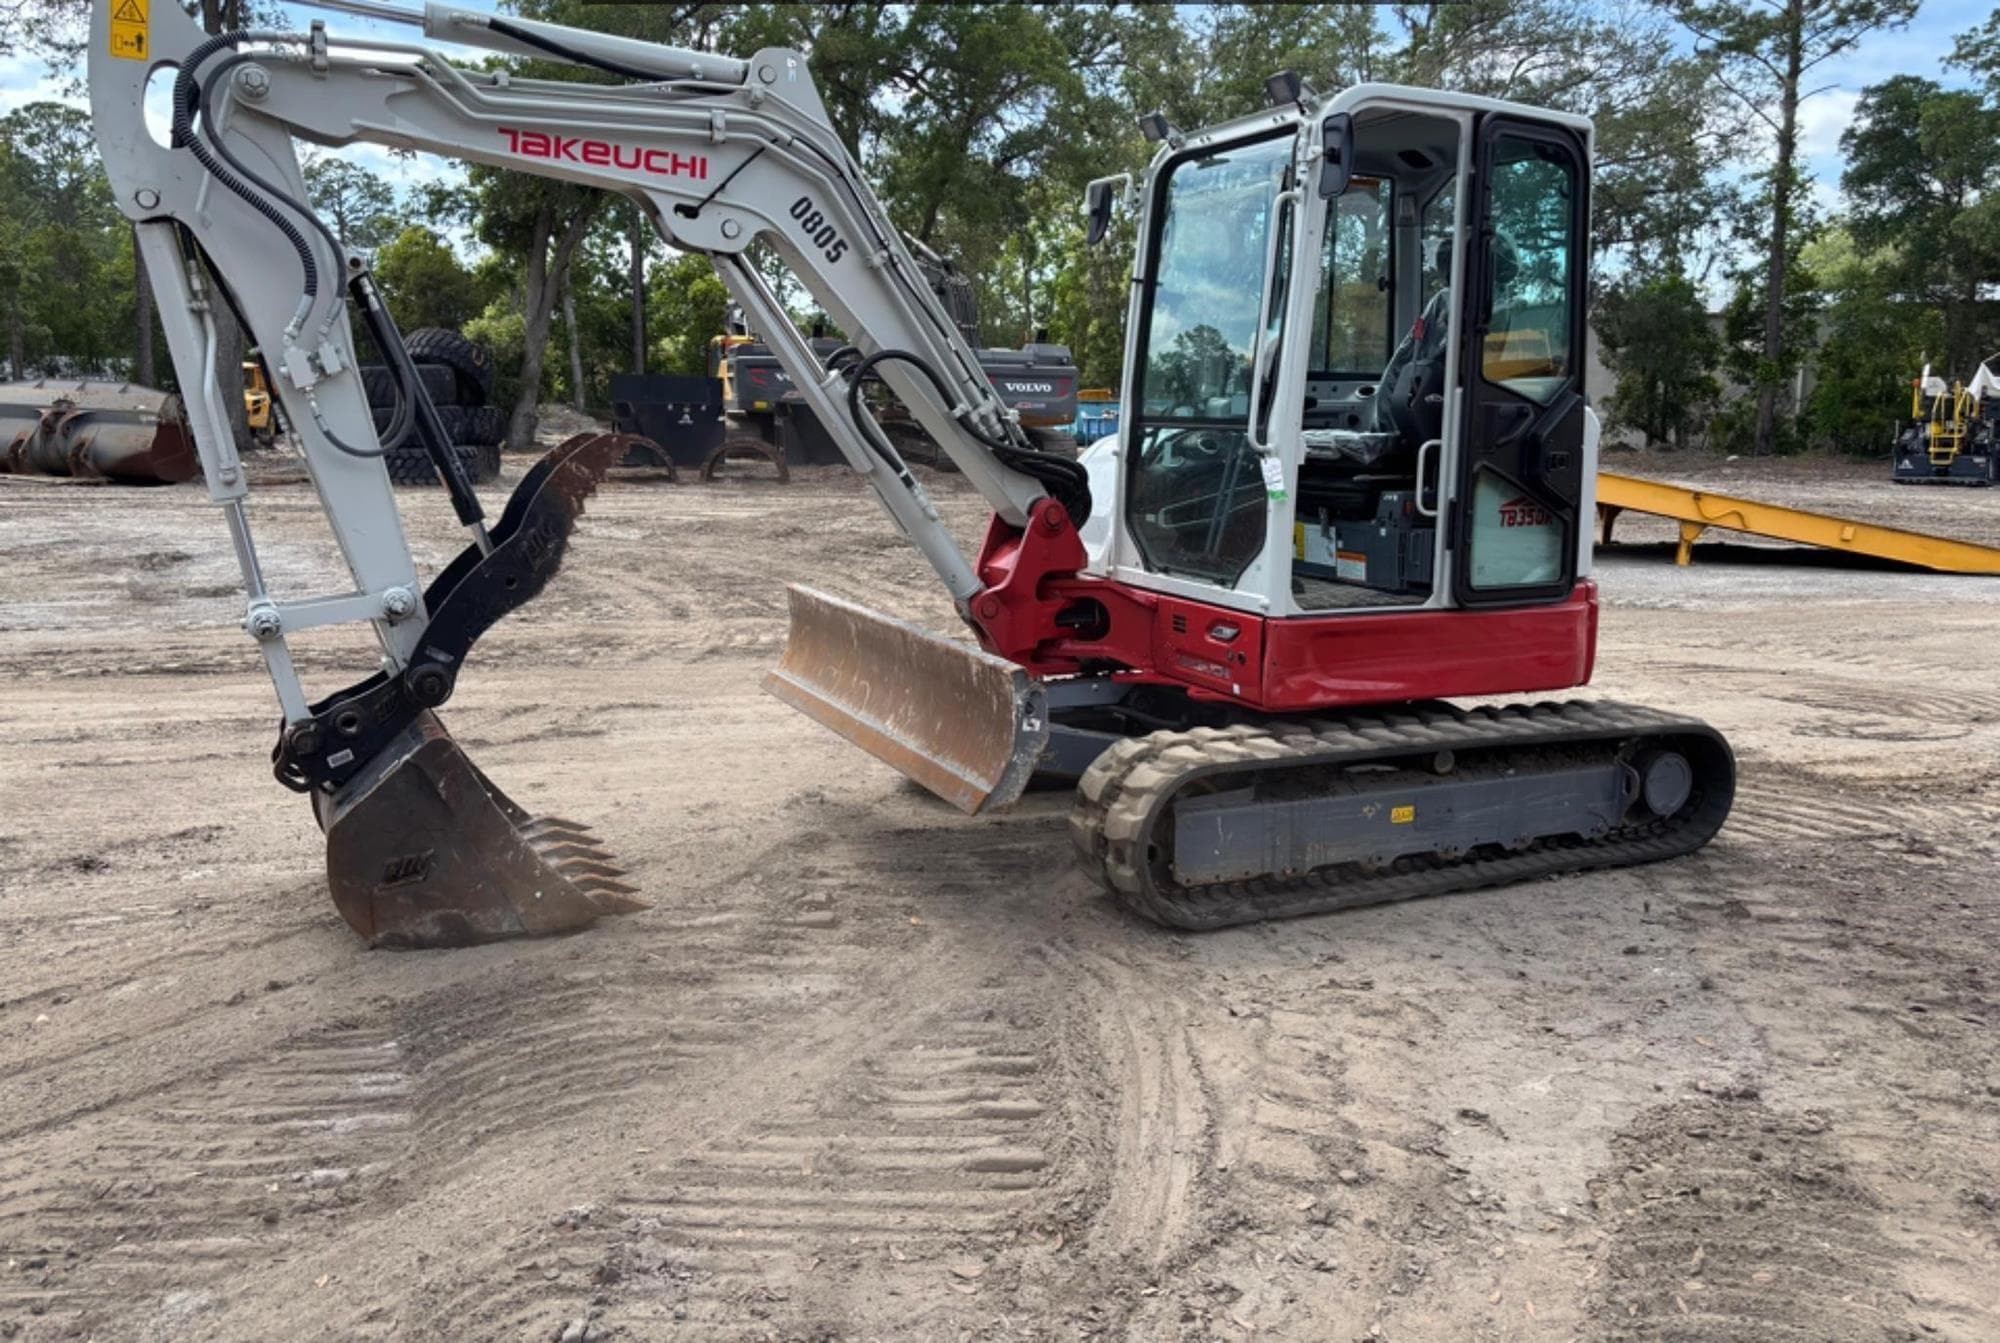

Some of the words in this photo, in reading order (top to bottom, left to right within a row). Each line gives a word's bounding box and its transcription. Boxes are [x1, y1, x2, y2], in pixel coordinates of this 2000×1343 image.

[497, 127, 707, 180] TAKEUCHI
[789, 196, 849, 263] 0805
[1004, 382, 1052, 393] VOLVO
